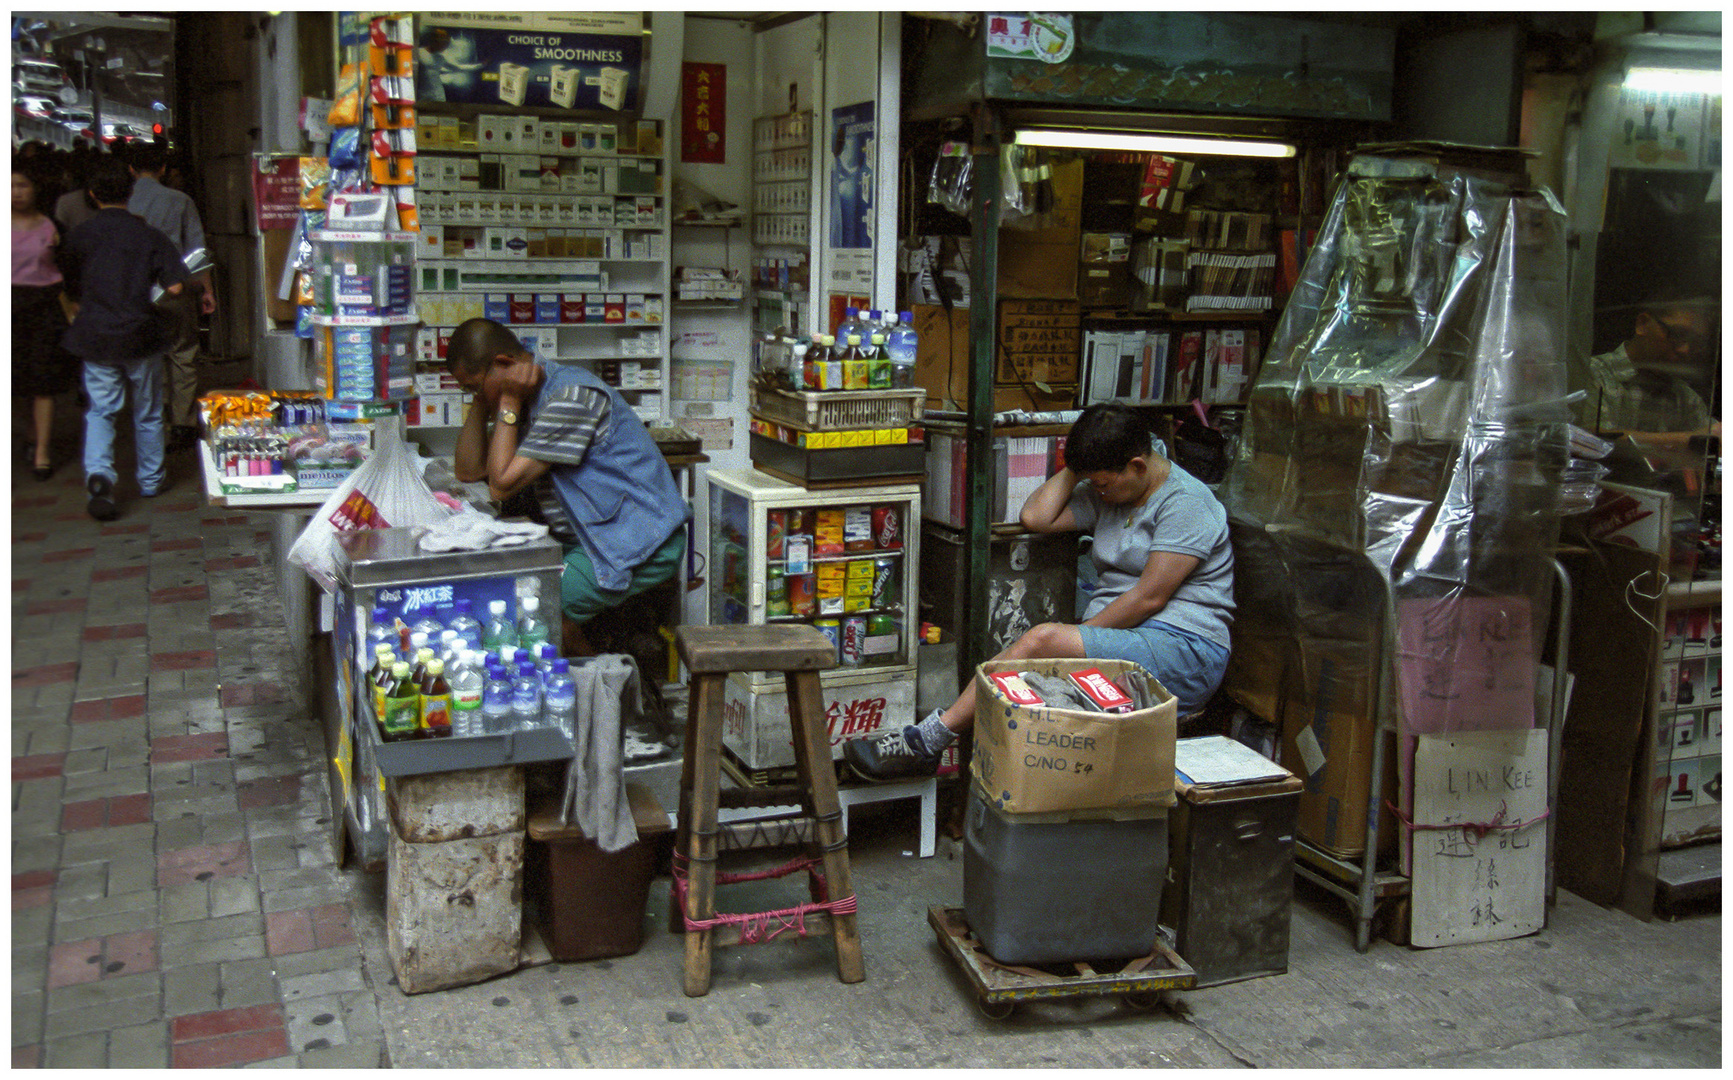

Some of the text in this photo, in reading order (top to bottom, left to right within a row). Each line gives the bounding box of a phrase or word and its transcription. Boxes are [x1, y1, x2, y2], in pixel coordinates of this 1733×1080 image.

[508, 35, 562, 47] CHOICE OF
[534, 47, 623, 63] SMOOTHNESS
[300, 471, 344, 480] mentos
[402, 585, 453, 614] 冰紅茶
[1026, 730, 1096, 750] LEADER
[1448, 765, 1532, 794] LIN KEE
